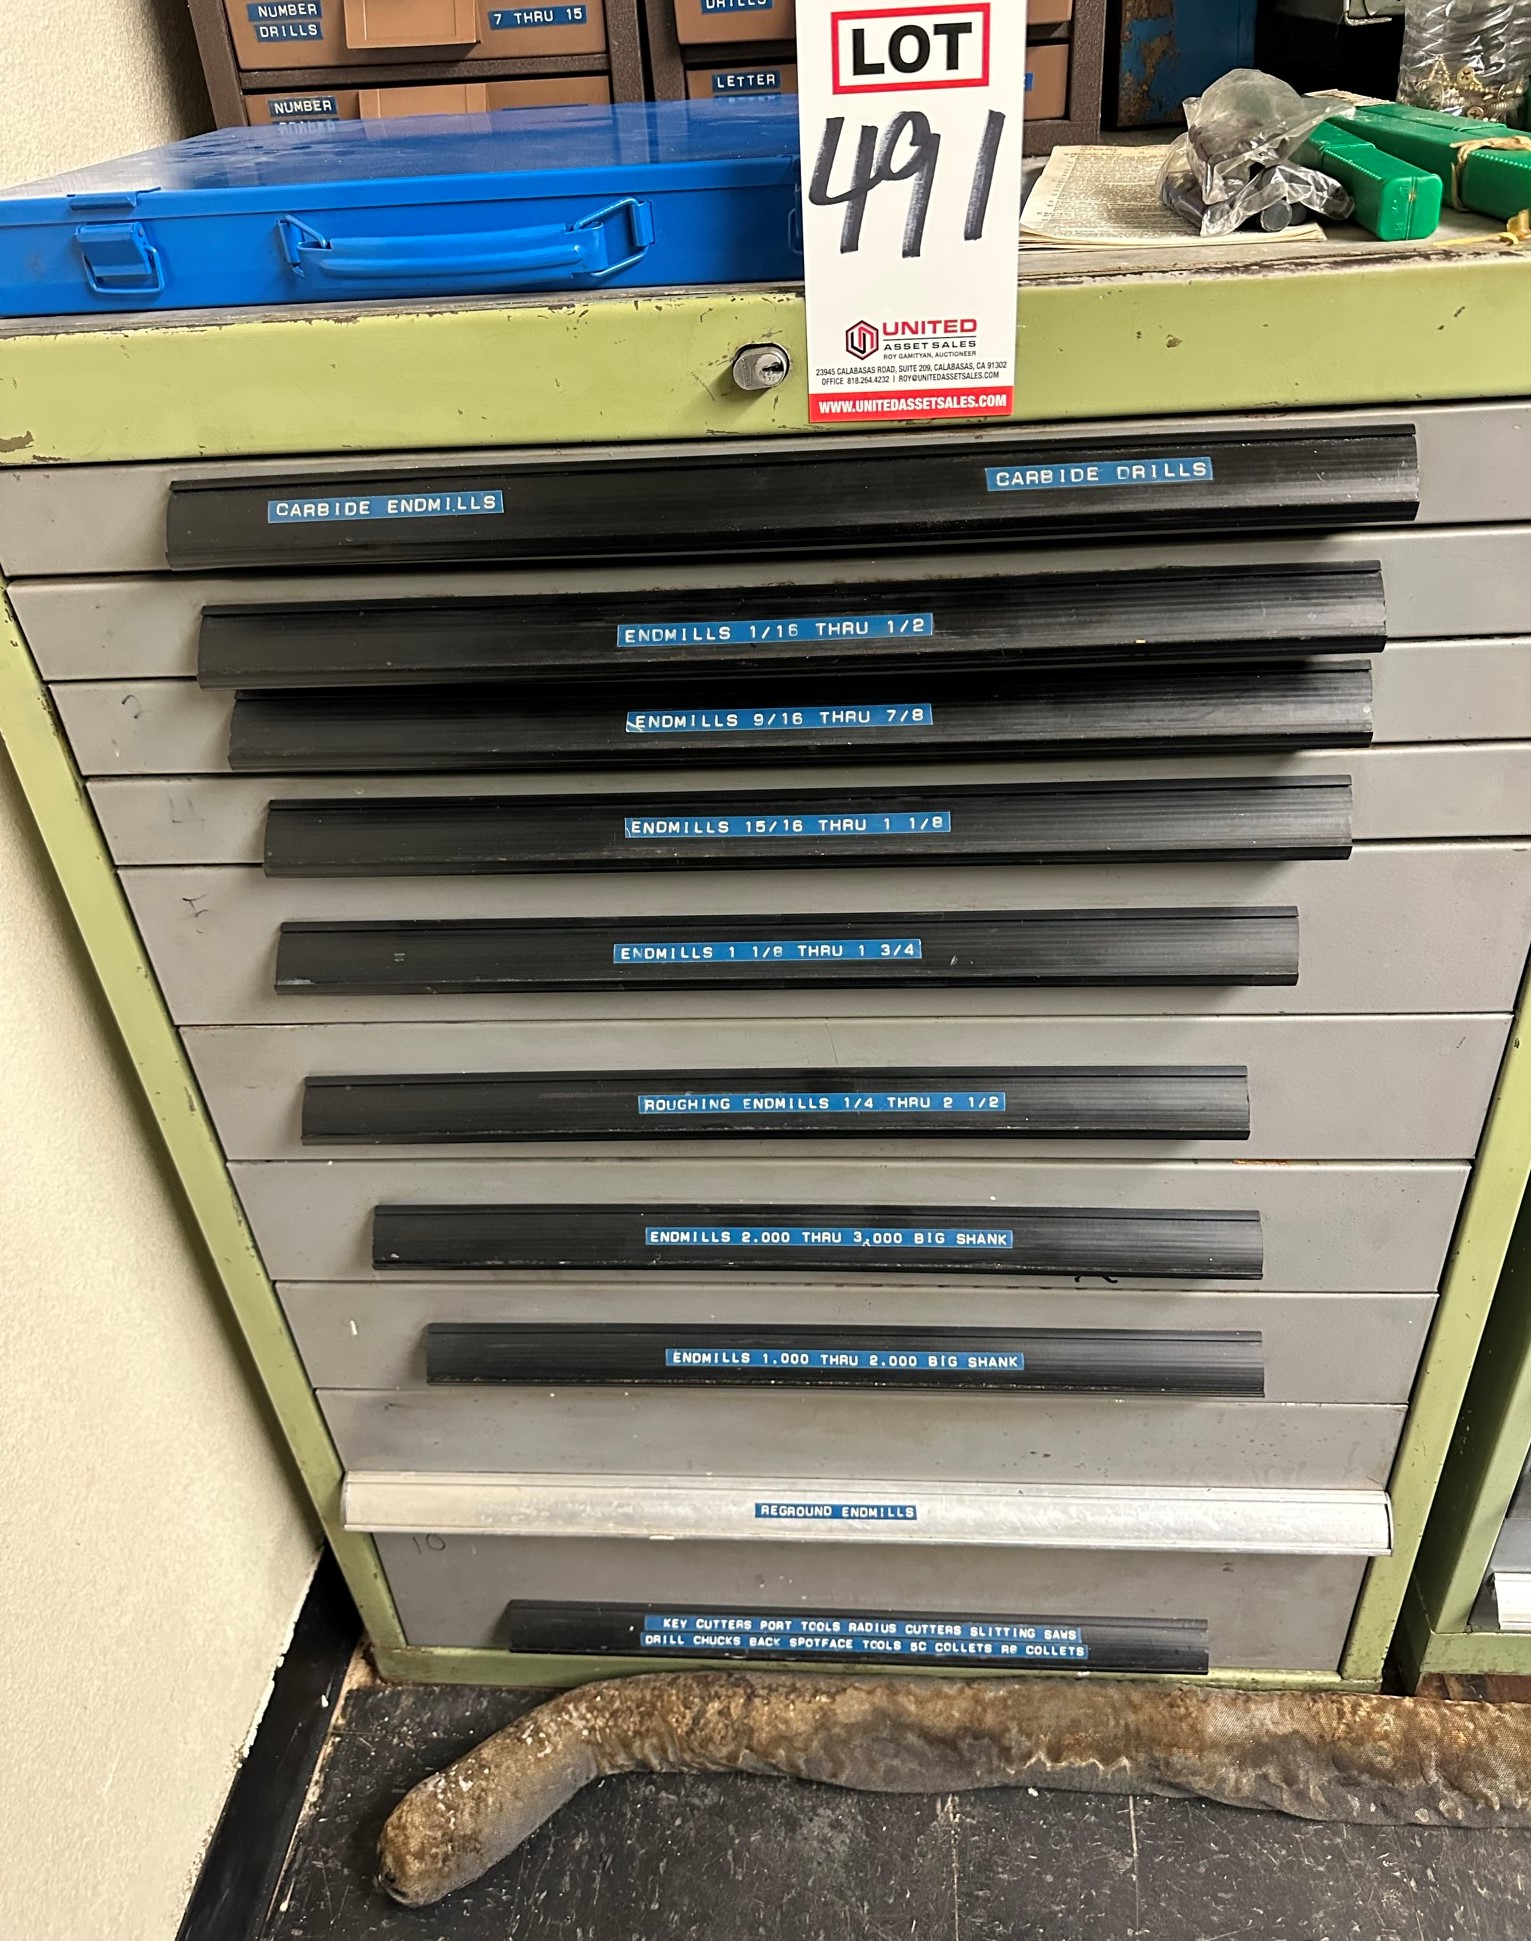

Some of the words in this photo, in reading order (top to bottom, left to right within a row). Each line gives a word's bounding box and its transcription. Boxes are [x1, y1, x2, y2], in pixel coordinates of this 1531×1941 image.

[258, 3, 318, 18] NUMBER
[493, 14, 502, 25] 7
[513, 10, 554, 25] THRU
[566, 7, 582, 20] 15
[259, 23, 318, 38] DRILLS
[851, 23, 973, 76] LOT
[717, 74, 775, 88] LETTER
[274, 99, 332, 114] NUMBER
[808, 108, 1006, 259] 491
[882, 318, 977, 336] UNITED
[883, 342, 929, 351] ASSET
[932, 340, 976, 349] SALES
[935, 350, 977, 358] AUCTIONEER
[816, 368, 836, 376] 23945
[837, 366, 876, 375] CALABASAS
[877, 366, 897, 374] ROAD,
[898, 365, 918, 373] SUITE
[919, 364, 933, 373] 209,
[934, 362, 975, 371] CALABASAS,
[987, 361, 1007, 369] 91302
[821, 377, 844, 385] OFFICE
[847, 375, 890, 385] 818.264.4232
[898, 372, 999, 382] ROY@UNITEDASSETSALES.COM
[818, 394, 1007, 414] WWW.UNITEDASSETSALES.COM
[996, 466, 1099, 486] CARBIDE
[1117, 461, 1207, 480] DRILLS
[276, 501, 371, 517] CARBIDE
[387, 495, 496, 514] ENDMILLS
[624, 626, 731, 643] ENDMILLS
[749, 623, 799, 640] 1/16
[815, 622, 869, 636] THRU
[887, 618, 925, 633] 1/2
[636, 714, 738, 729] ENDMILLS
[753, 712, 803, 726] 9/16
[820, 710, 870, 724] THRU
[887, 708, 924, 722] 7/8
[631, 821, 730, 834] ENDMILLS
[745, 819, 803, 833] 15/16
[818, 818, 867, 832] THRU
[883, 818, 891, 830] 1
[909, 816, 943, 830] 1/8
[621, 946, 713, 960] ENDMILLS
[728, 946, 735, 958] 1
[752, 945, 783, 958] 1/8
[797, 944, 843, 957] THRU
[858, 944, 865, 956] 1
[880, 944, 914, 956] 3/4
[644, 1098, 731, 1112] ROUGHING
[742, 1097, 829, 1110] ENDMILLS
[843, 1096, 874, 1109] 1/4
[887, 1096, 930, 1108] THRU
[943, 1096, 953, 1108] 2
[967, 1095, 1000, 1108] 1/2
[650, 1230, 731, 1244] ENDMILLS
[741, 1230, 790, 1244] 2.000
[801, 1231, 842, 1244] THRU
[914, 1232, 945, 1244] BIG
[956, 1232, 1007, 1245] SHANK
[672, 1351, 751, 1364] ENDMILLS
[762, 1353, 809, 1365] 1.000
[820, 1353, 858, 1366] THRU
[869, 1355, 917, 1367] 2.000
[928, 1354, 958, 1368] BIG
[968, 1355, 1018, 1368] SHANK
[760, 1505, 832, 1518] REGROUND
[841, 1506, 915, 1519] ENDMILLS
[663, 1618, 687, 1628] KEY
[696, 1619, 752, 1630] CUTTERS
[760, 1620, 792, 1631] PORT
[801, 1621, 841, 1632] TOOLS
[849, 1622, 896, 1634] RADIUS
[905, 1624, 961, 1636] CUTTERS
[970, 1626, 1035, 1639] SLITTING
[1044, 1629, 1077, 1640] SAWS
[645, 1635, 684, 1645] DRILL
[693, 1636, 741, 1646] CHUCKS
[749, 1637, 781, 1647] BACK
[789, 1638, 853, 1649] SPOTFACE
[863, 1640, 901, 1650] TOOLS
[935, 1642, 992, 1653] COLLETS
[1025, 1645, 1085, 1657] COLLETS
